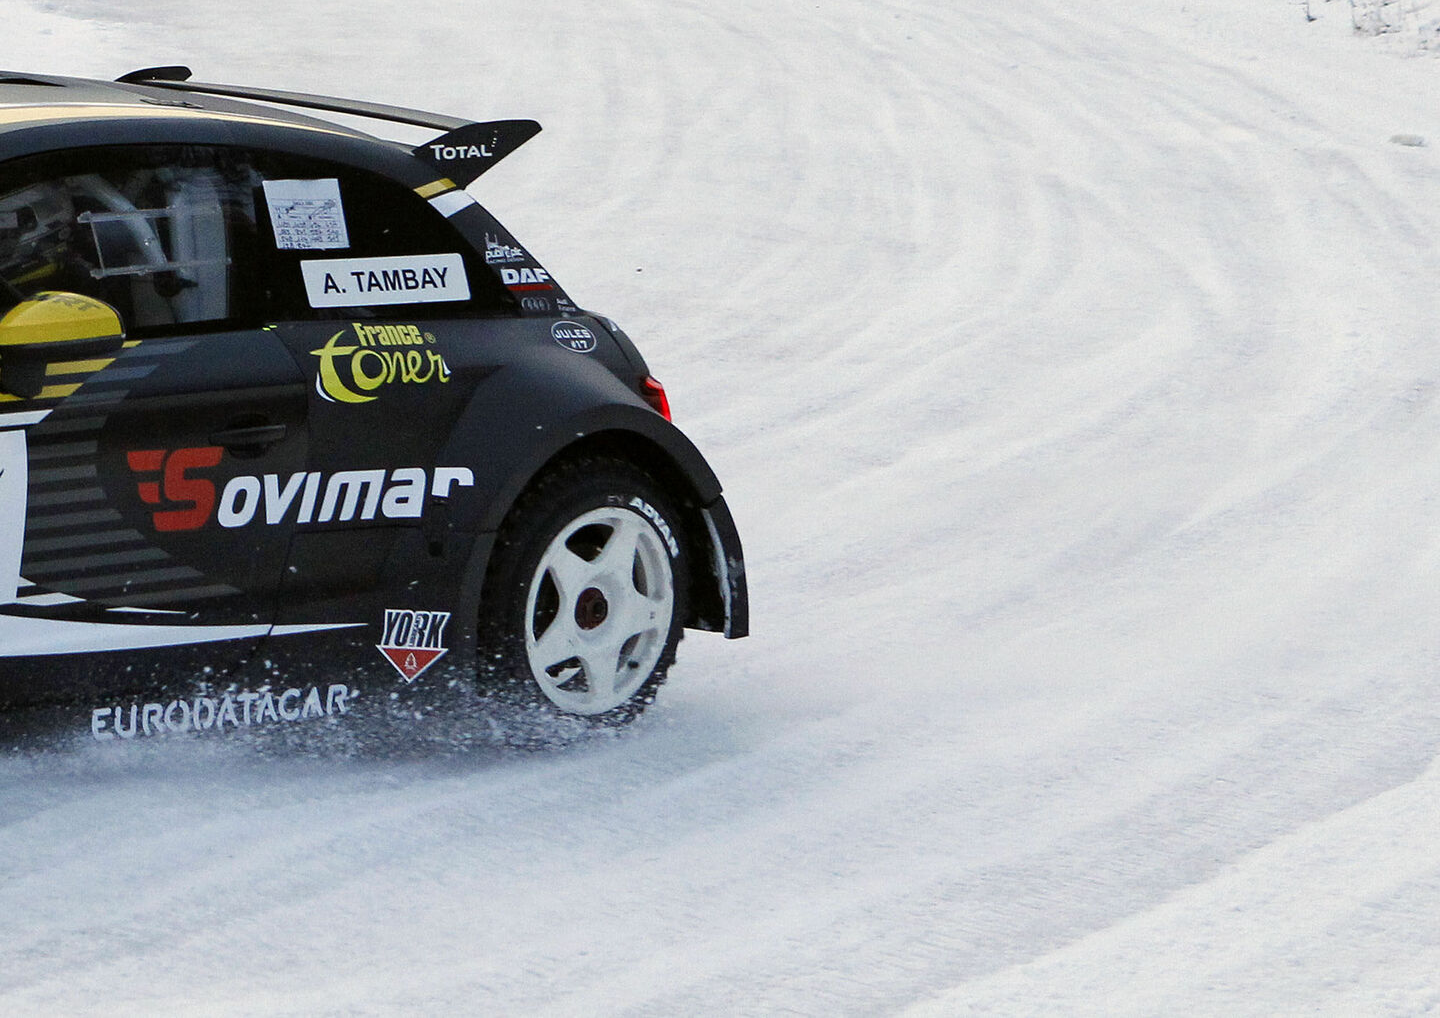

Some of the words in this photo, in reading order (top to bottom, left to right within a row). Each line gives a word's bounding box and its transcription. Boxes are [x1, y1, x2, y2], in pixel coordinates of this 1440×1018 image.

[324, 272, 346, 294] A.
[351, 267, 449, 293] TAMBAY
[500, 268, 551, 285] DAF
[555, 329, 592, 339] JULES
[628, 495, 680, 559] ADVAN
[383, 608, 451, 649] YORK
[91, 683, 349, 740] EURODATACAR
